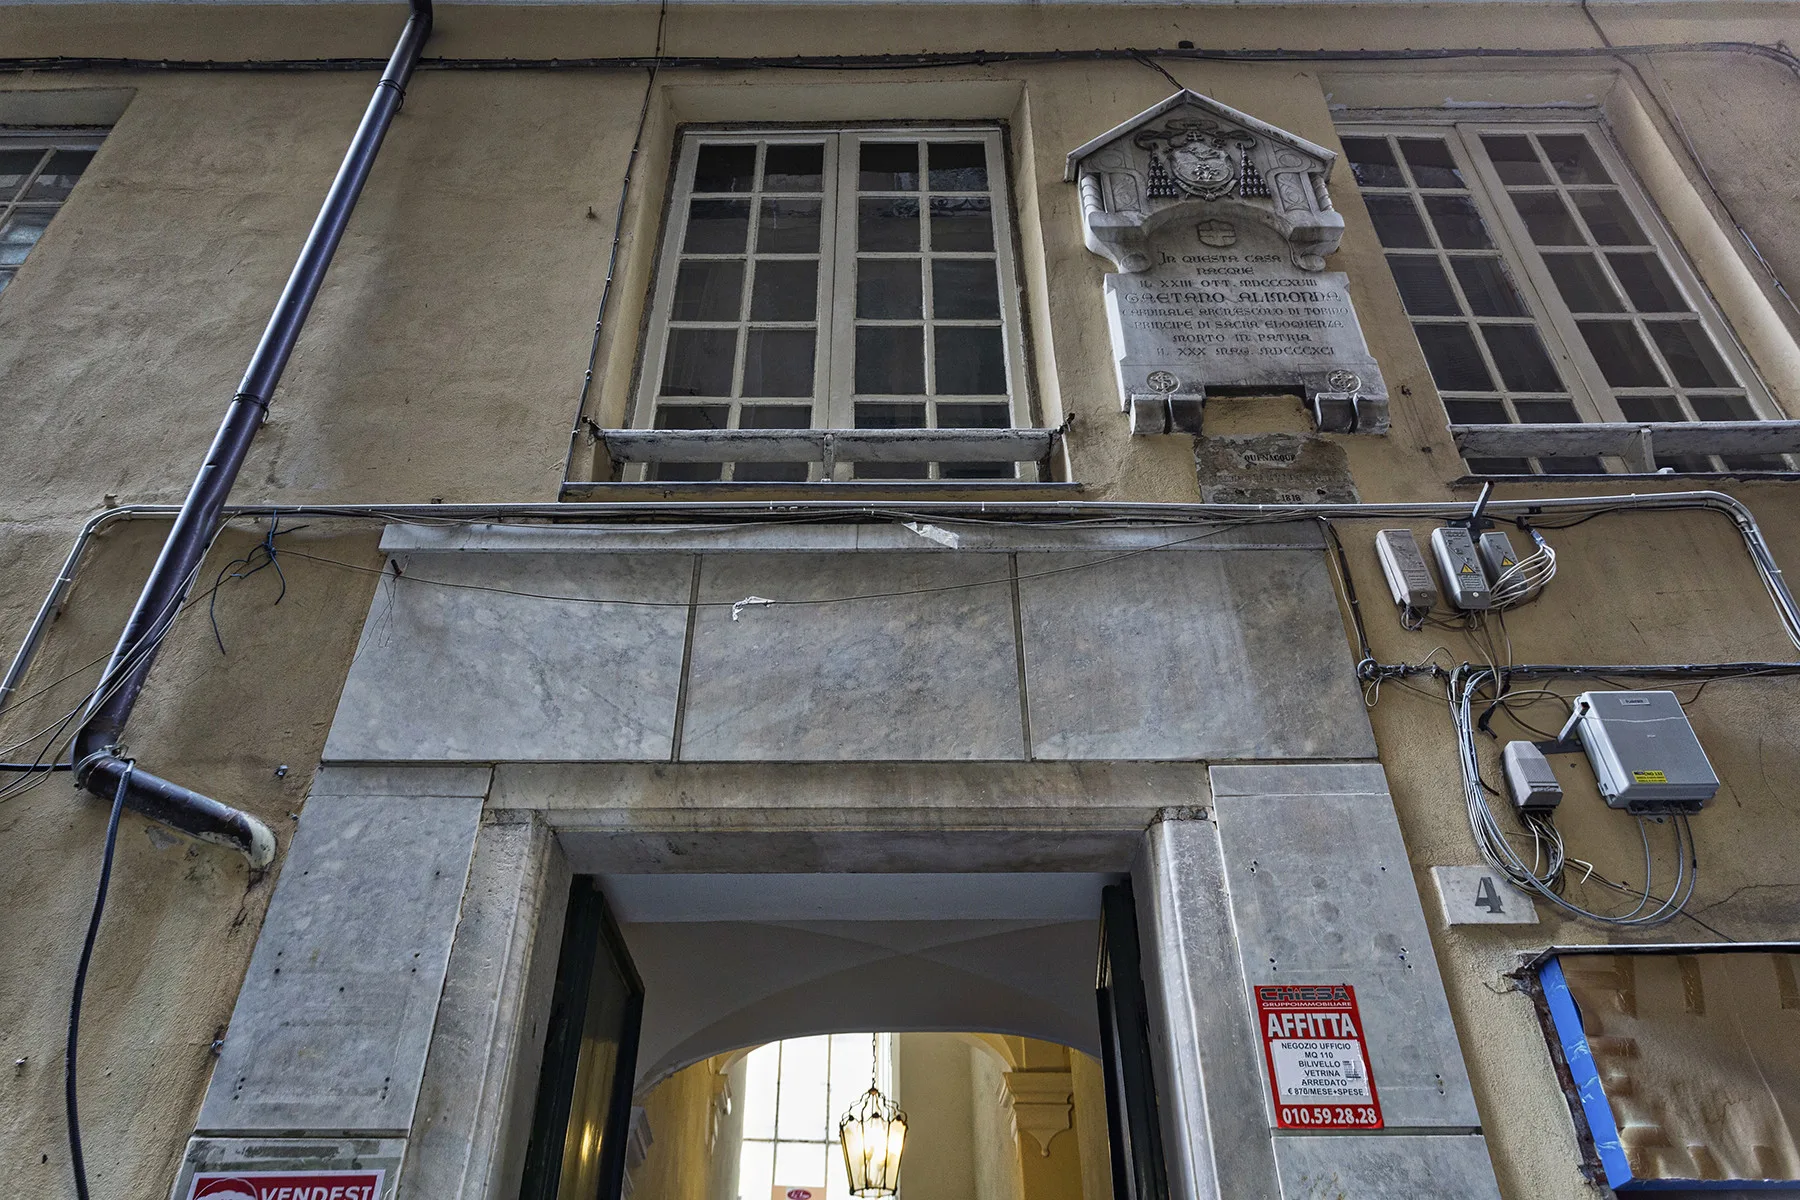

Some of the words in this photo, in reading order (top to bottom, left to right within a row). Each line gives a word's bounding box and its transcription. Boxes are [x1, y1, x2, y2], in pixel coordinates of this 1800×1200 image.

[1182, 255, 1238, 264] QUESTA
[1244, 254, 1282, 263] CASA
[1196, 266, 1254, 276] NACQUE
[1160, 279, 1193, 288] XXIII
[1124, 292, 1226, 304] GAETANO
[1239, 291, 1342, 303] ALIMONDA
[1122, 308, 1194, 316] CARDINALE
[1288, 307, 1300, 316] DI
[1304, 307, 1349, 316] TORINO
[1134, 320, 1193, 330] PRINCIPE
[1198, 320, 1210, 329] DI
[1215, 320, 1260, 330] SACRA
[1172, 334, 1225, 344] MORTO
[1235, 334, 1250, 342] IN
[1258, 333, 1312, 343] PATRIA
[1178, 347, 1206, 356] XXX
[1475, 877, 1506, 914] 4
[1268, 1013, 1358, 1038] AFFITTA
[1282, 1108, 1377, 1124] 010.59.28.28
